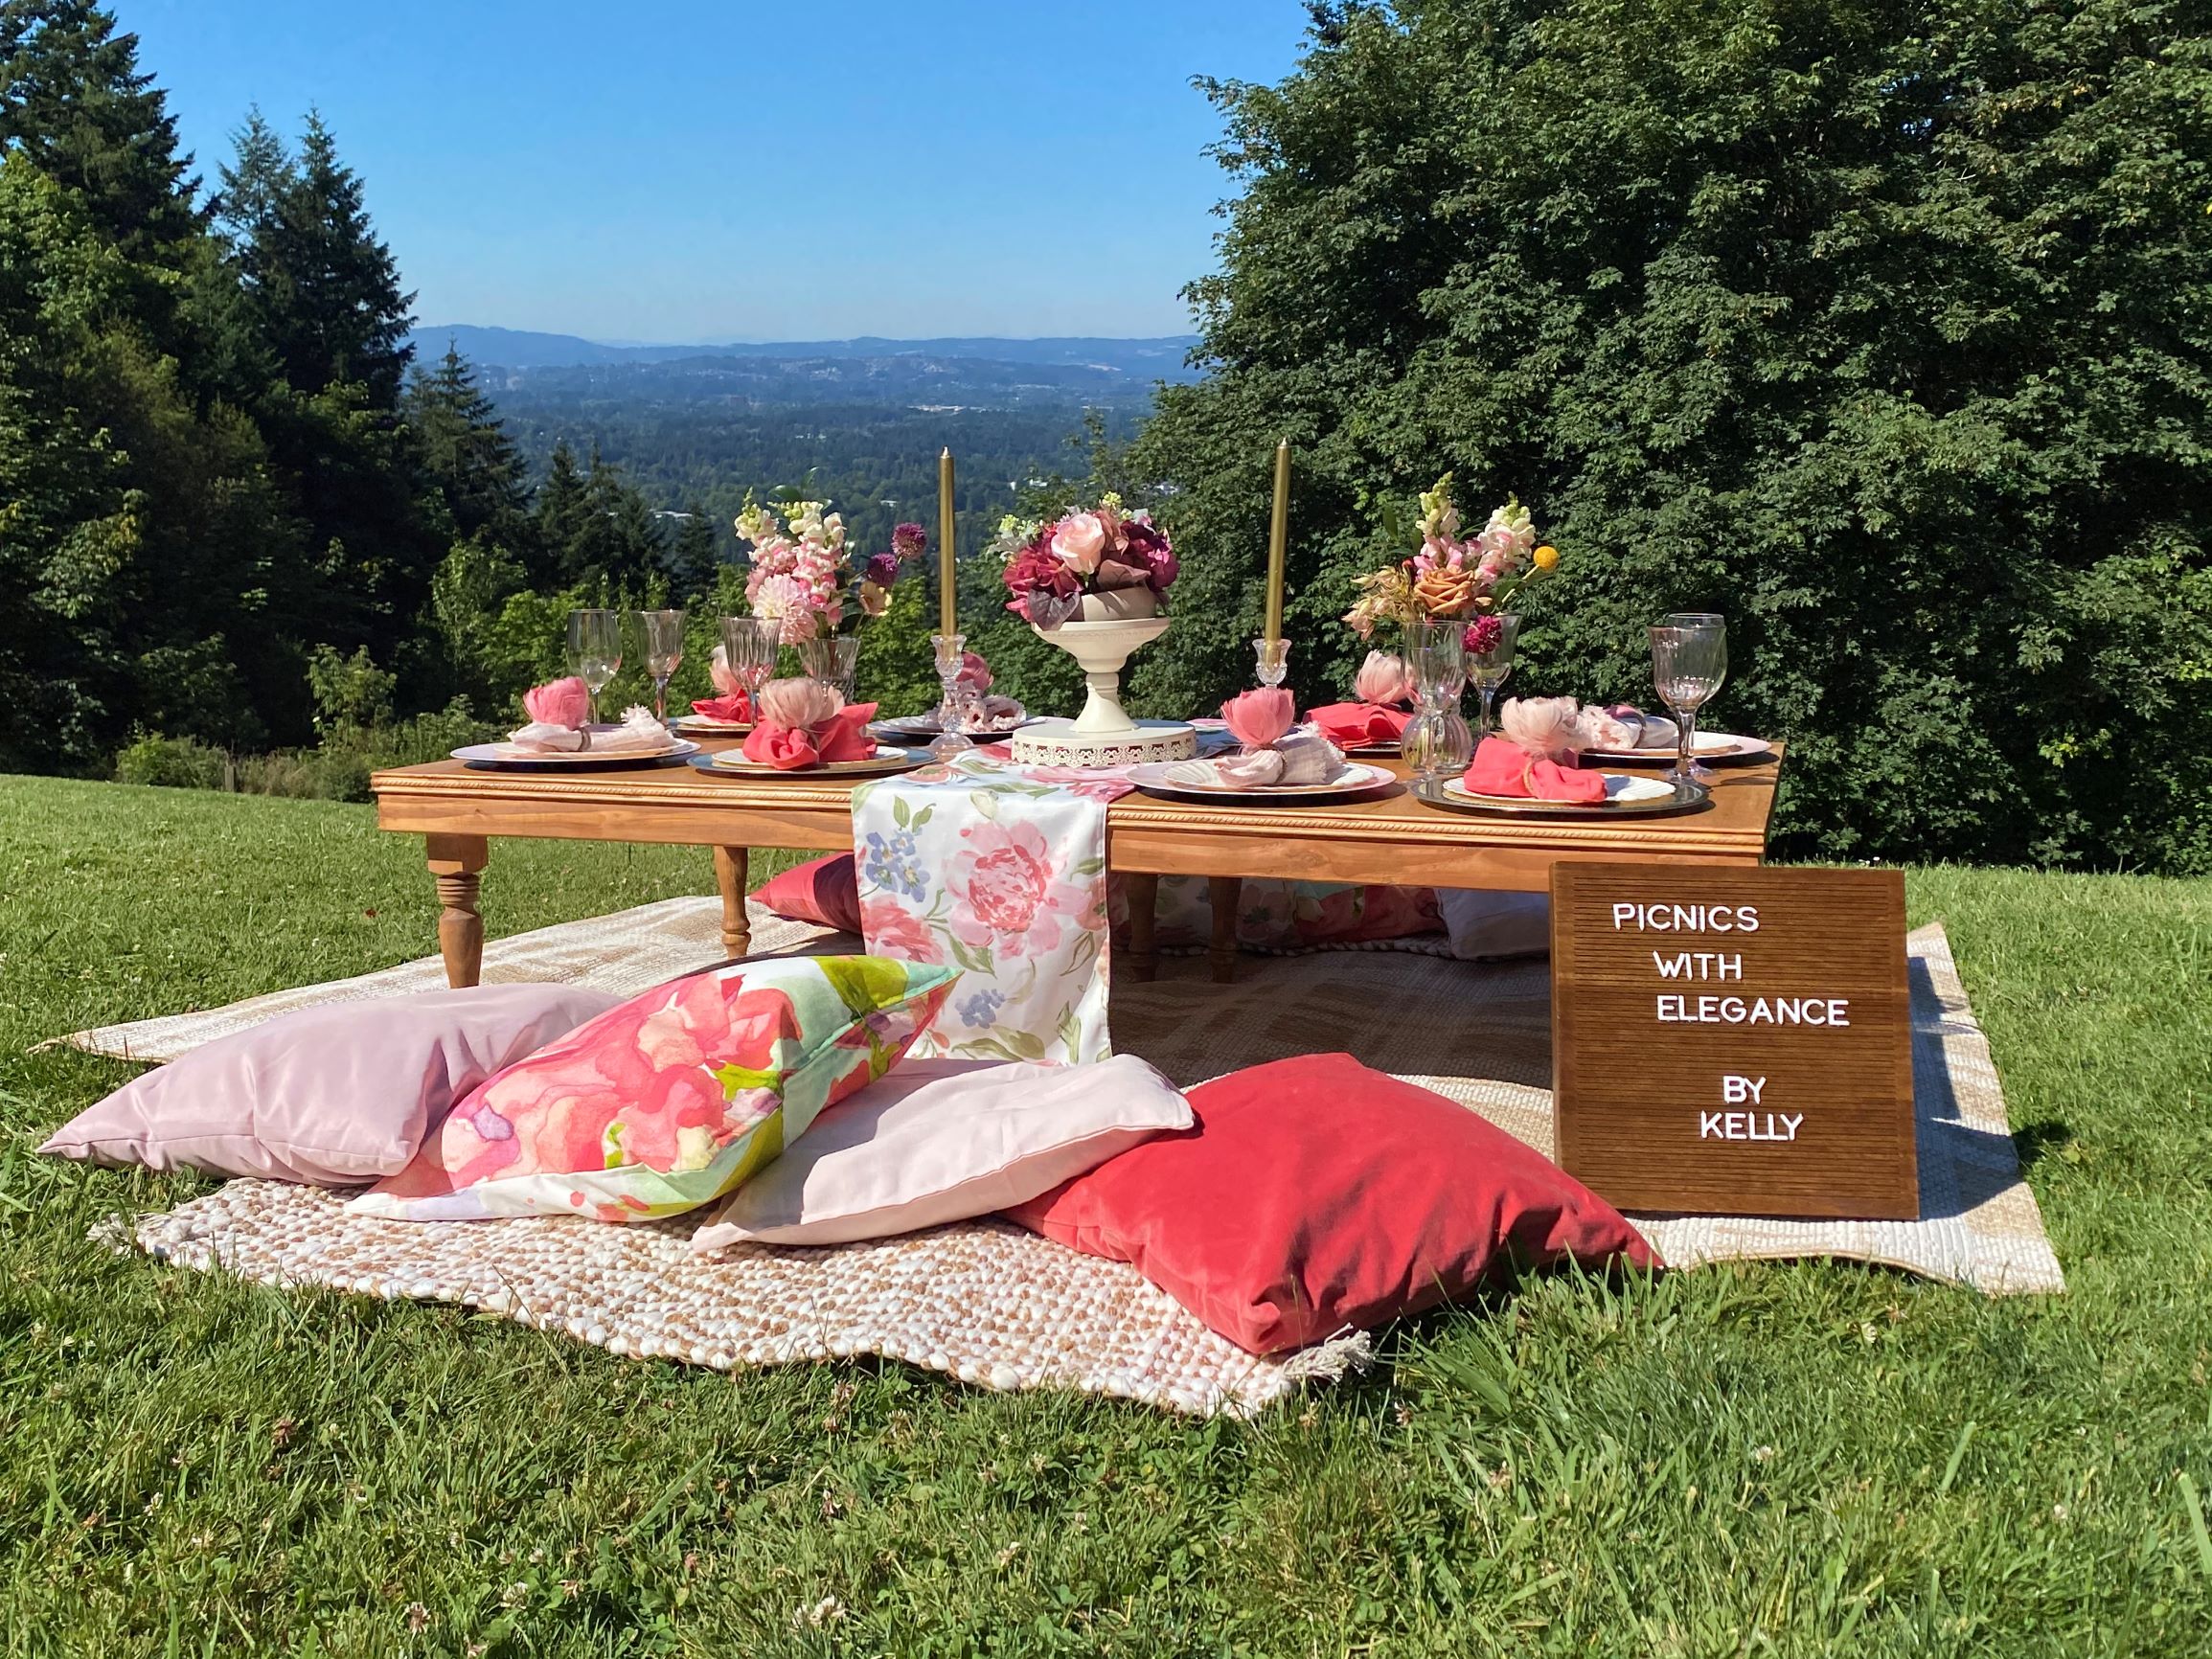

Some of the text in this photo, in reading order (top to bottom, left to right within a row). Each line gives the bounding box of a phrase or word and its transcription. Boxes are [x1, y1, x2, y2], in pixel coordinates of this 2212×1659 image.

[1612, 903, 1759, 932] PICNICS
[1653, 951, 1742, 980] WITH
[1656, 995, 1850, 1026] ELEGANCE
[1722, 1076, 1767, 1104] BY
[1700, 1111, 1804, 1141] KELLY
